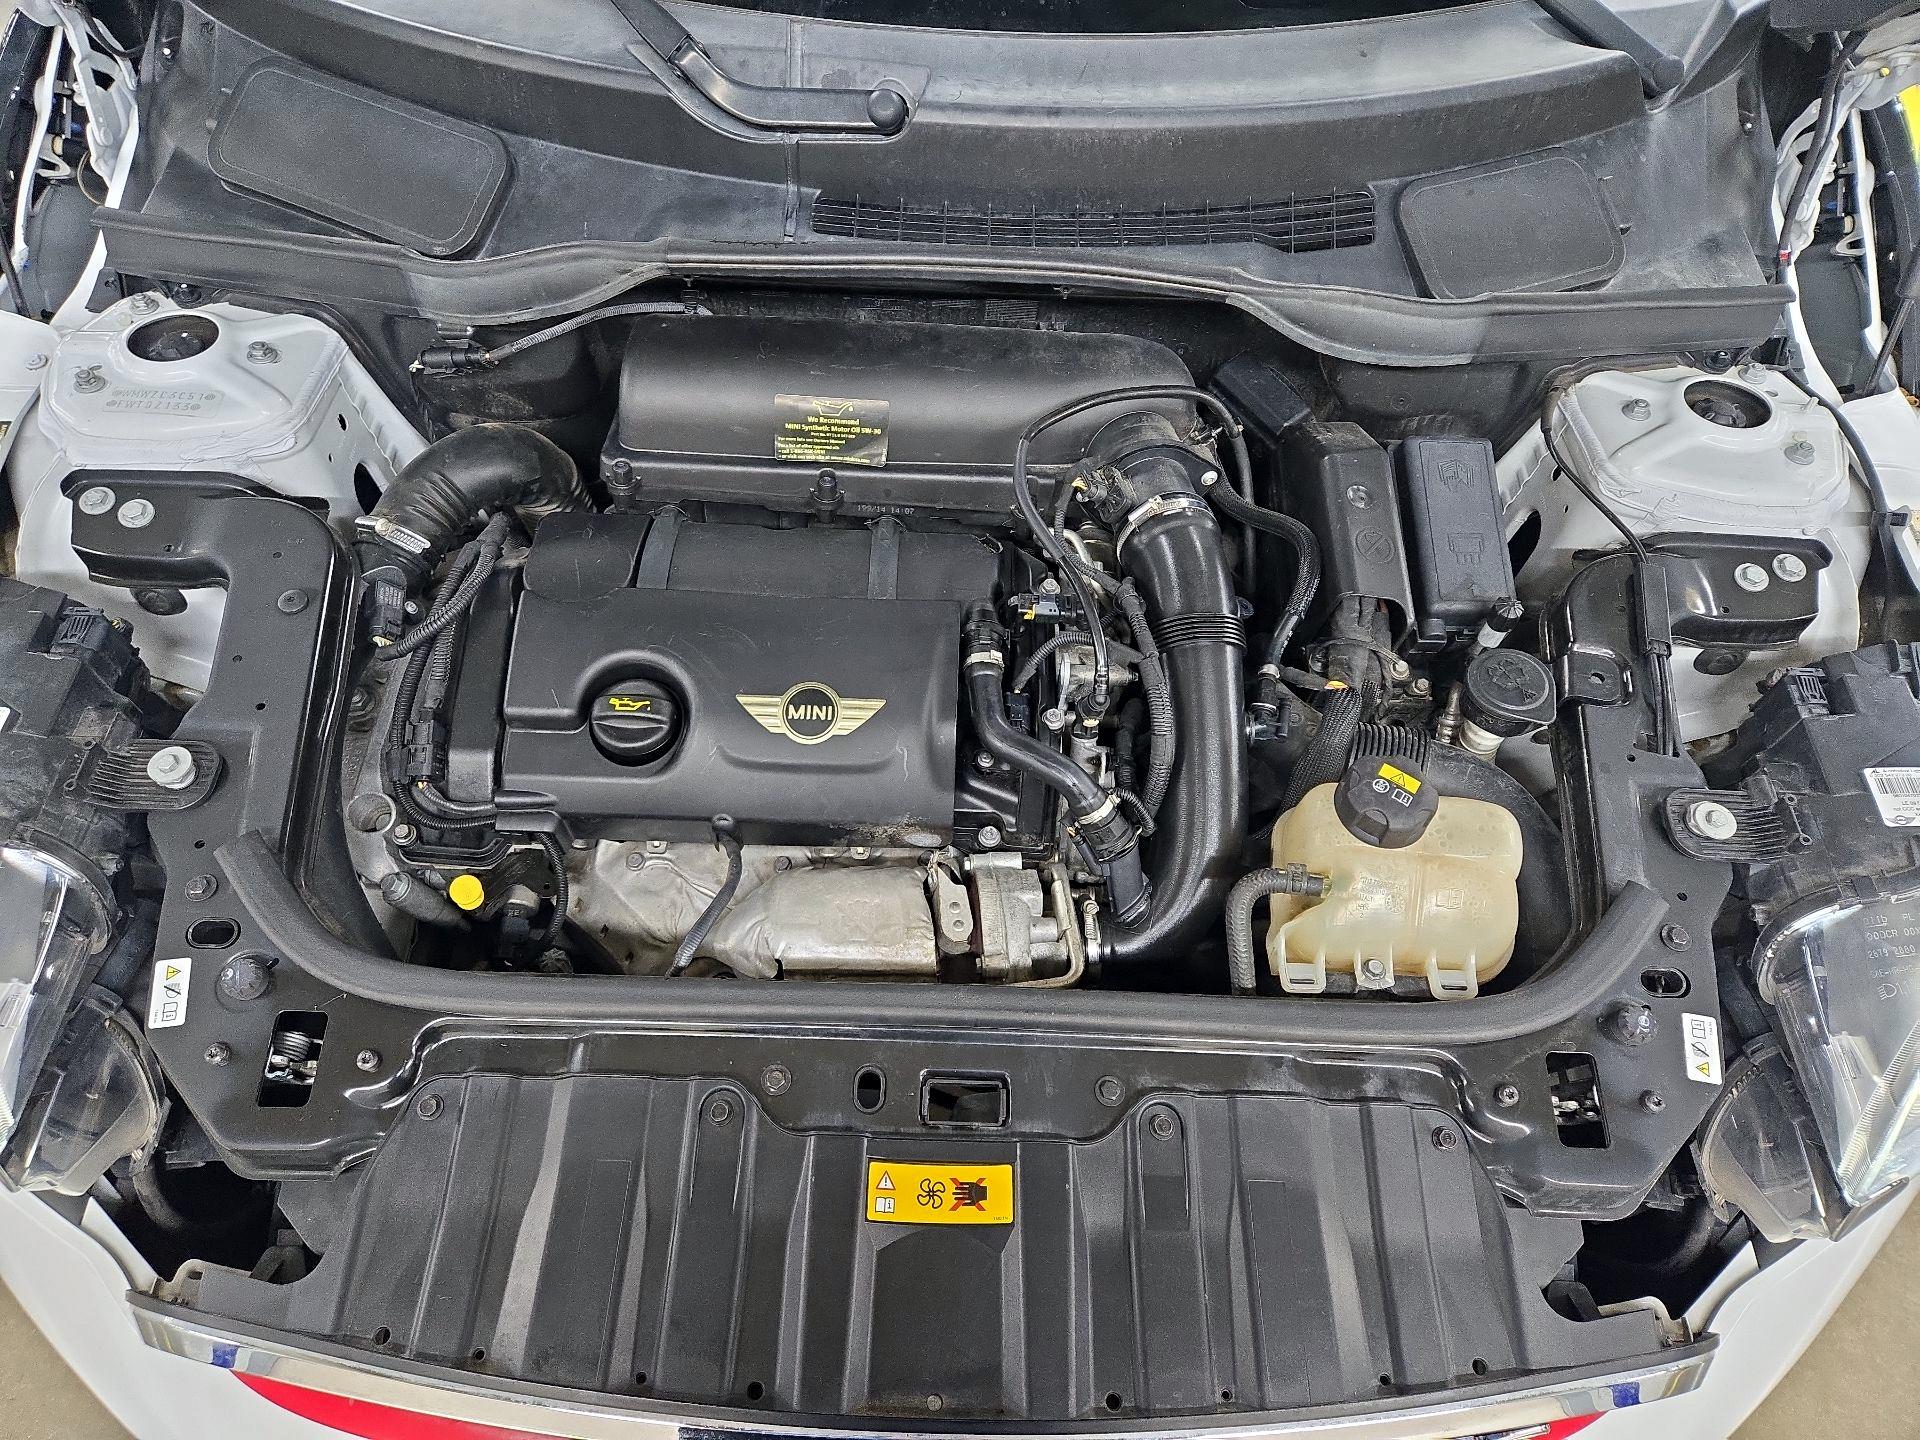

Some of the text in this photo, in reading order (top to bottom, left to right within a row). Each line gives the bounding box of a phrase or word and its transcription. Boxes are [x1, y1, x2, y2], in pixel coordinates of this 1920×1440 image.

[819, 417, 860, 426] Recommend
[801, 424, 831, 432] Synthetic
[787, 703, 833, 721] MINI
